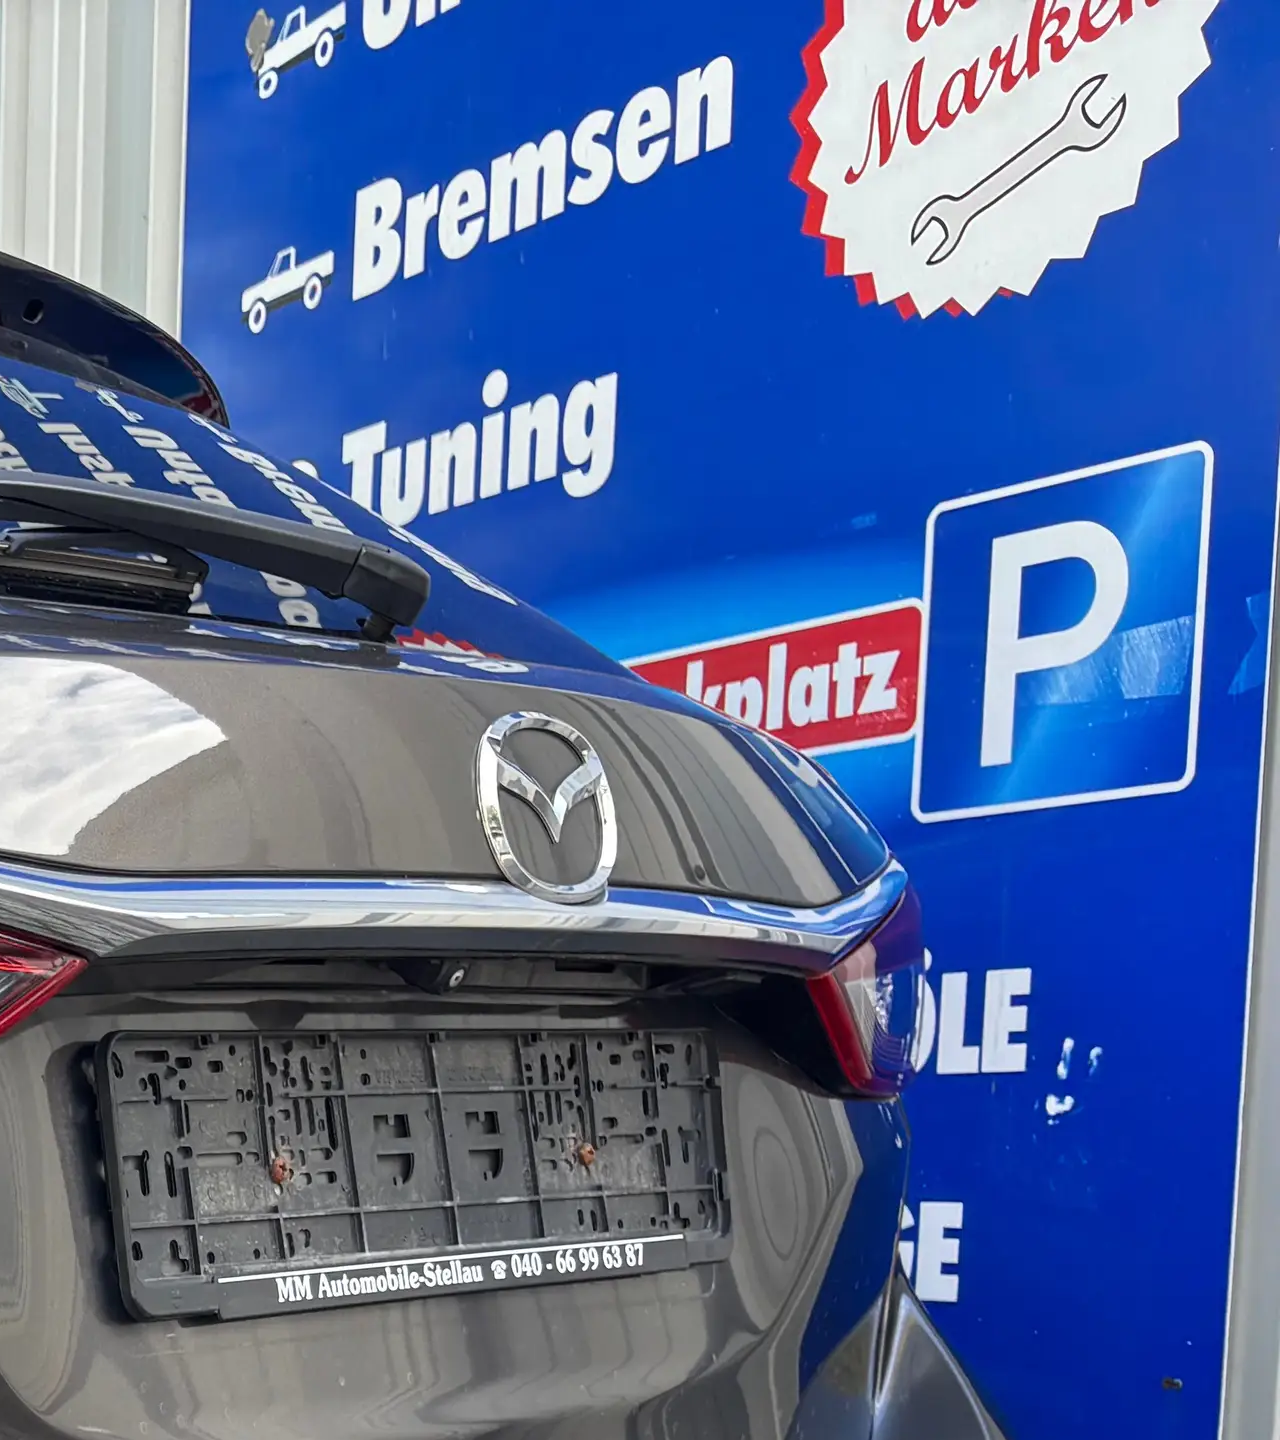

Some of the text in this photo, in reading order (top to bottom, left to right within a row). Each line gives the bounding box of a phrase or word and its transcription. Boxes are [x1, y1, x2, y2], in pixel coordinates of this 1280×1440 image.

[351, 55, 734, 303] Bremsen
[844, 0, 1162, 184] Marke
[342, 368, 619, 528] Tuning
[980, 520, 1131, 768] P
[275, 1274, 313, 1303] MM
[318, 1259, 483, 1298] Automobile-Stellau
[510, 1252, 542, 1278] 040
[555, 1248, 576, 1273] 66
[578, 1247, 599, 1271] 99
[602, 1245, 623, 1269] 63
[624, 1243, 644, 1267] 87
